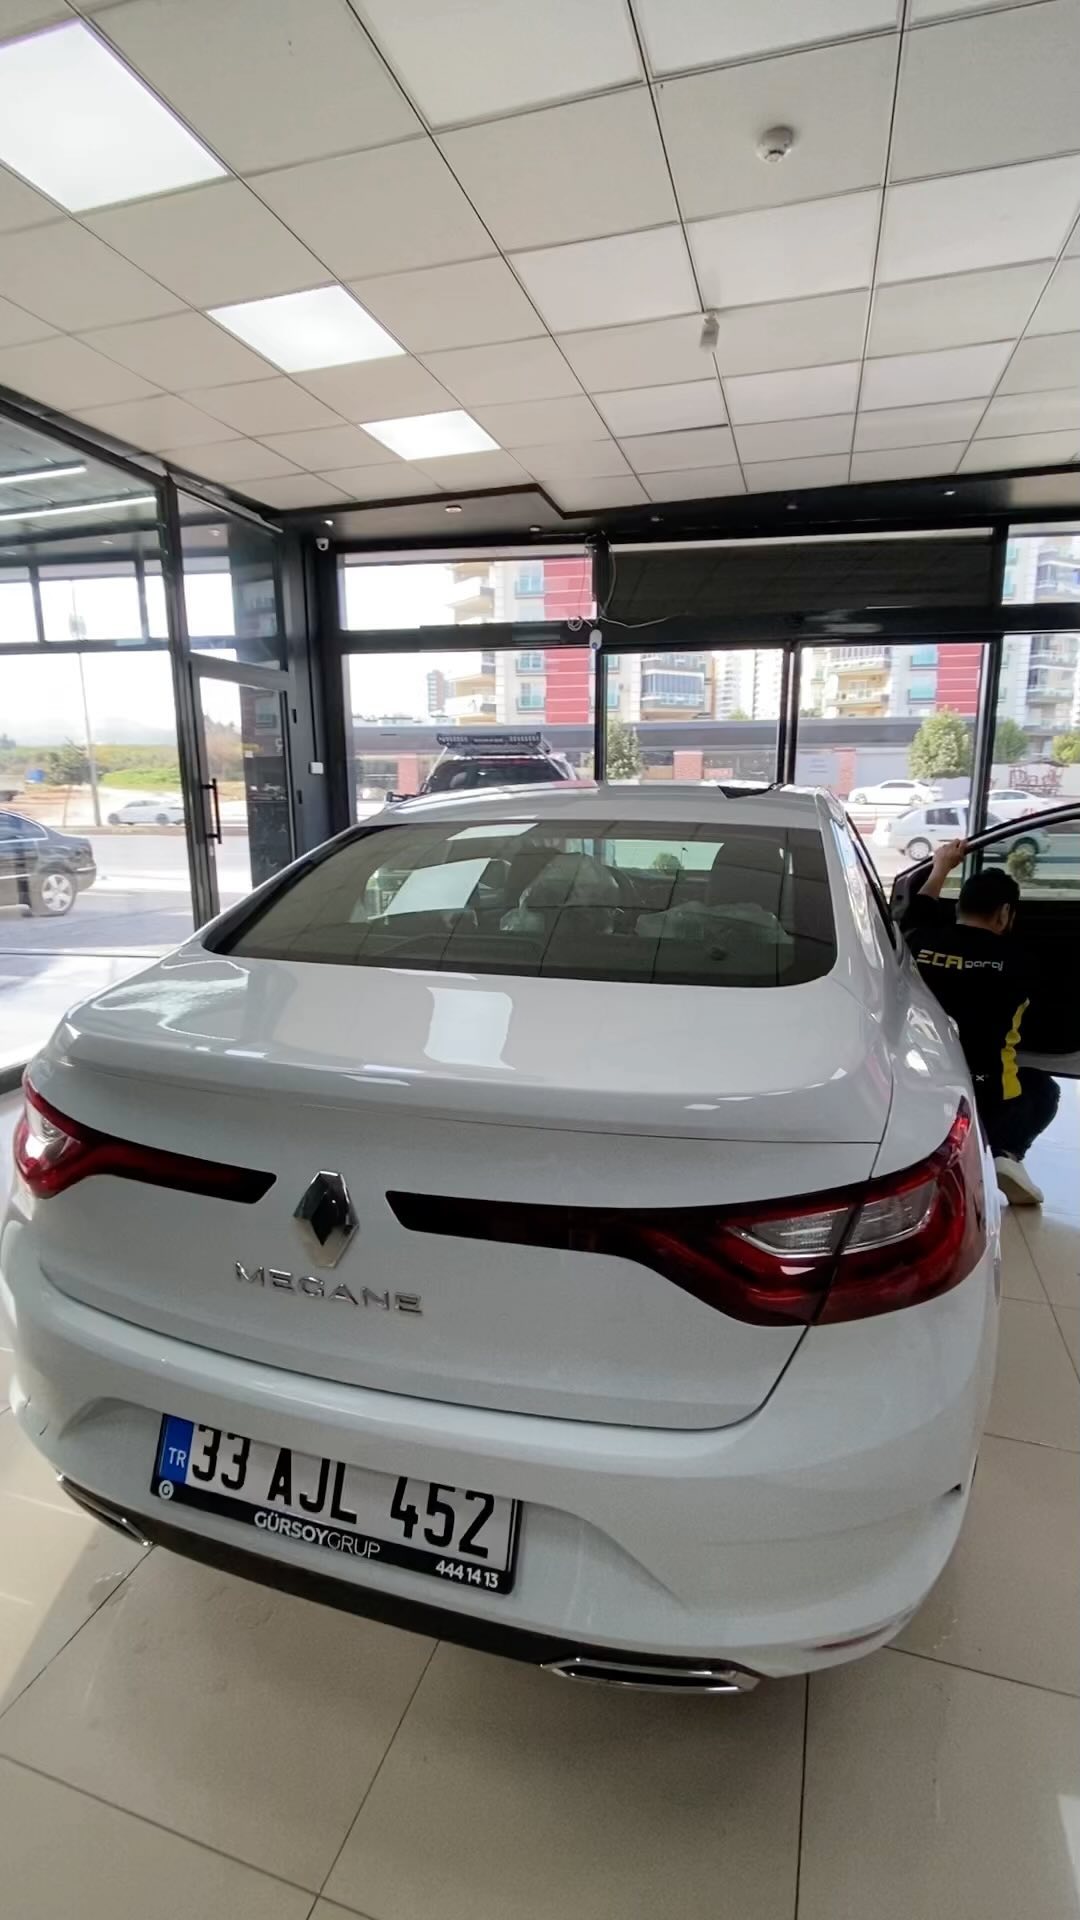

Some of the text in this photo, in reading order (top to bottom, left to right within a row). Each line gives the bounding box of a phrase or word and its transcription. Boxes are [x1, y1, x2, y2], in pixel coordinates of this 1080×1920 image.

[234, 1261, 422, 1315] MEGANE
[168, 1447, 187, 1469] TR
[192, 1423, 495, 1559] 33 AJL 452
[435, 1560, 464, 1579] 444
